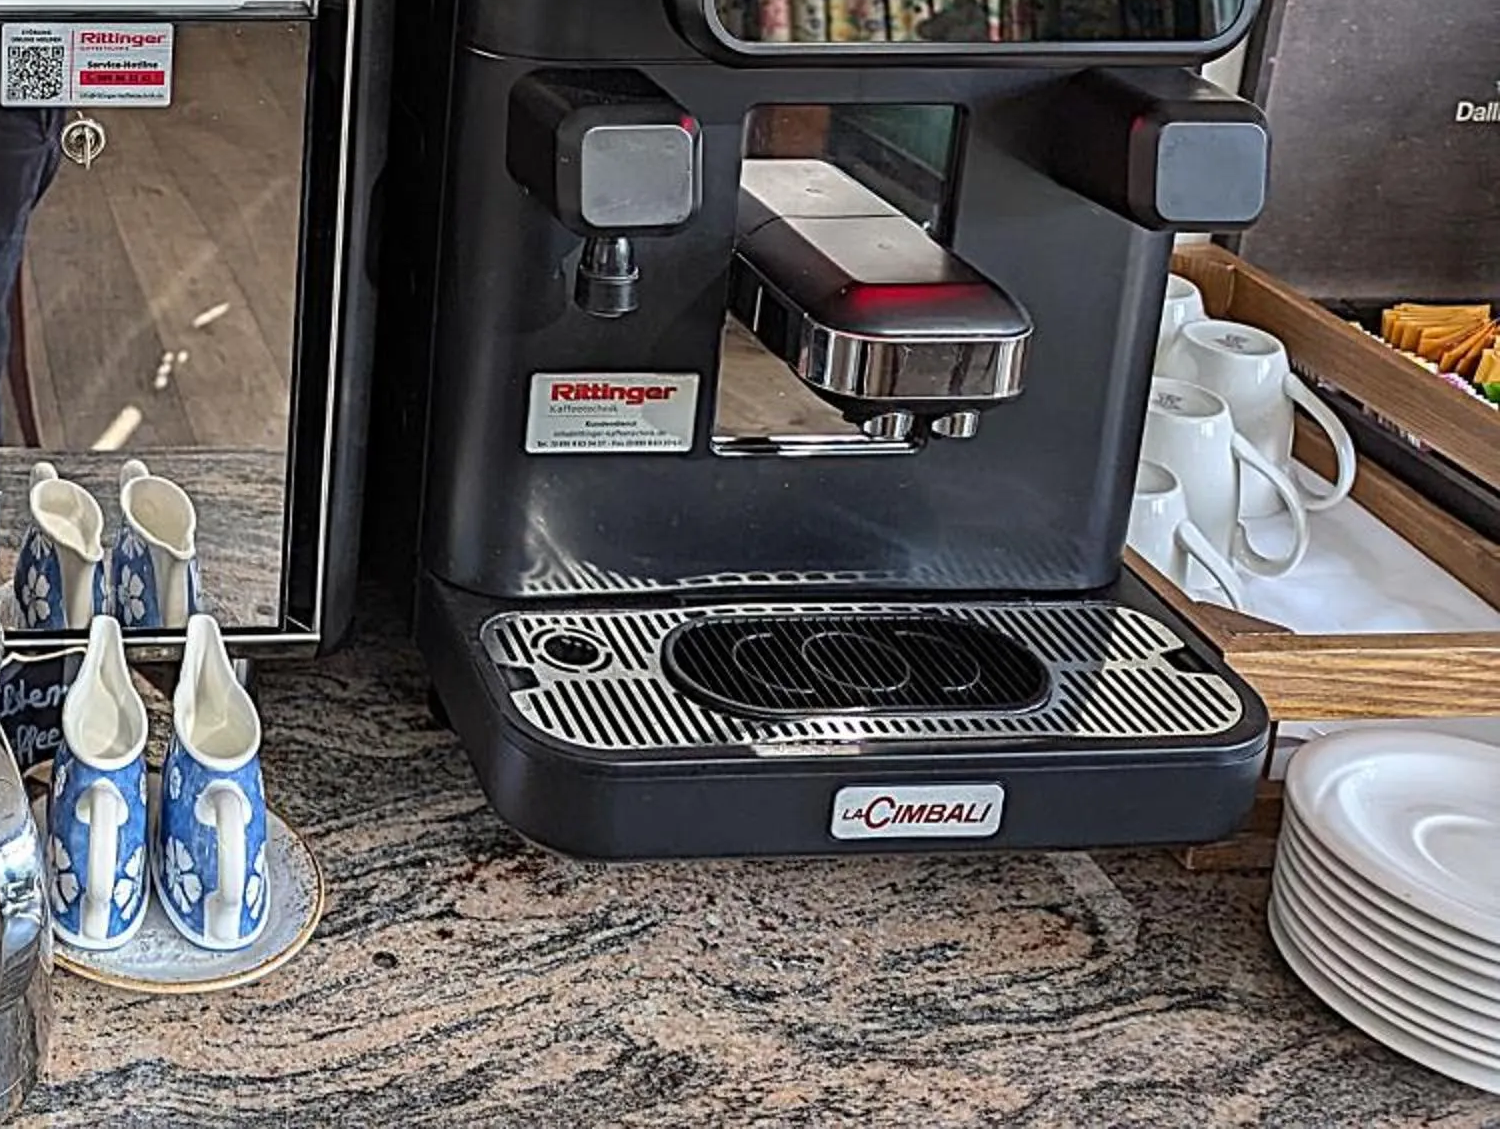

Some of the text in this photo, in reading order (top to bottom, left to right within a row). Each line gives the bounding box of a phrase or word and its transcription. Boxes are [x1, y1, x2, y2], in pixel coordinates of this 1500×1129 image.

[81, 32, 167, 48] Rittinger
[1456, 100, 1500, 123] Dall
[551, 382, 678, 405] Rittinger
